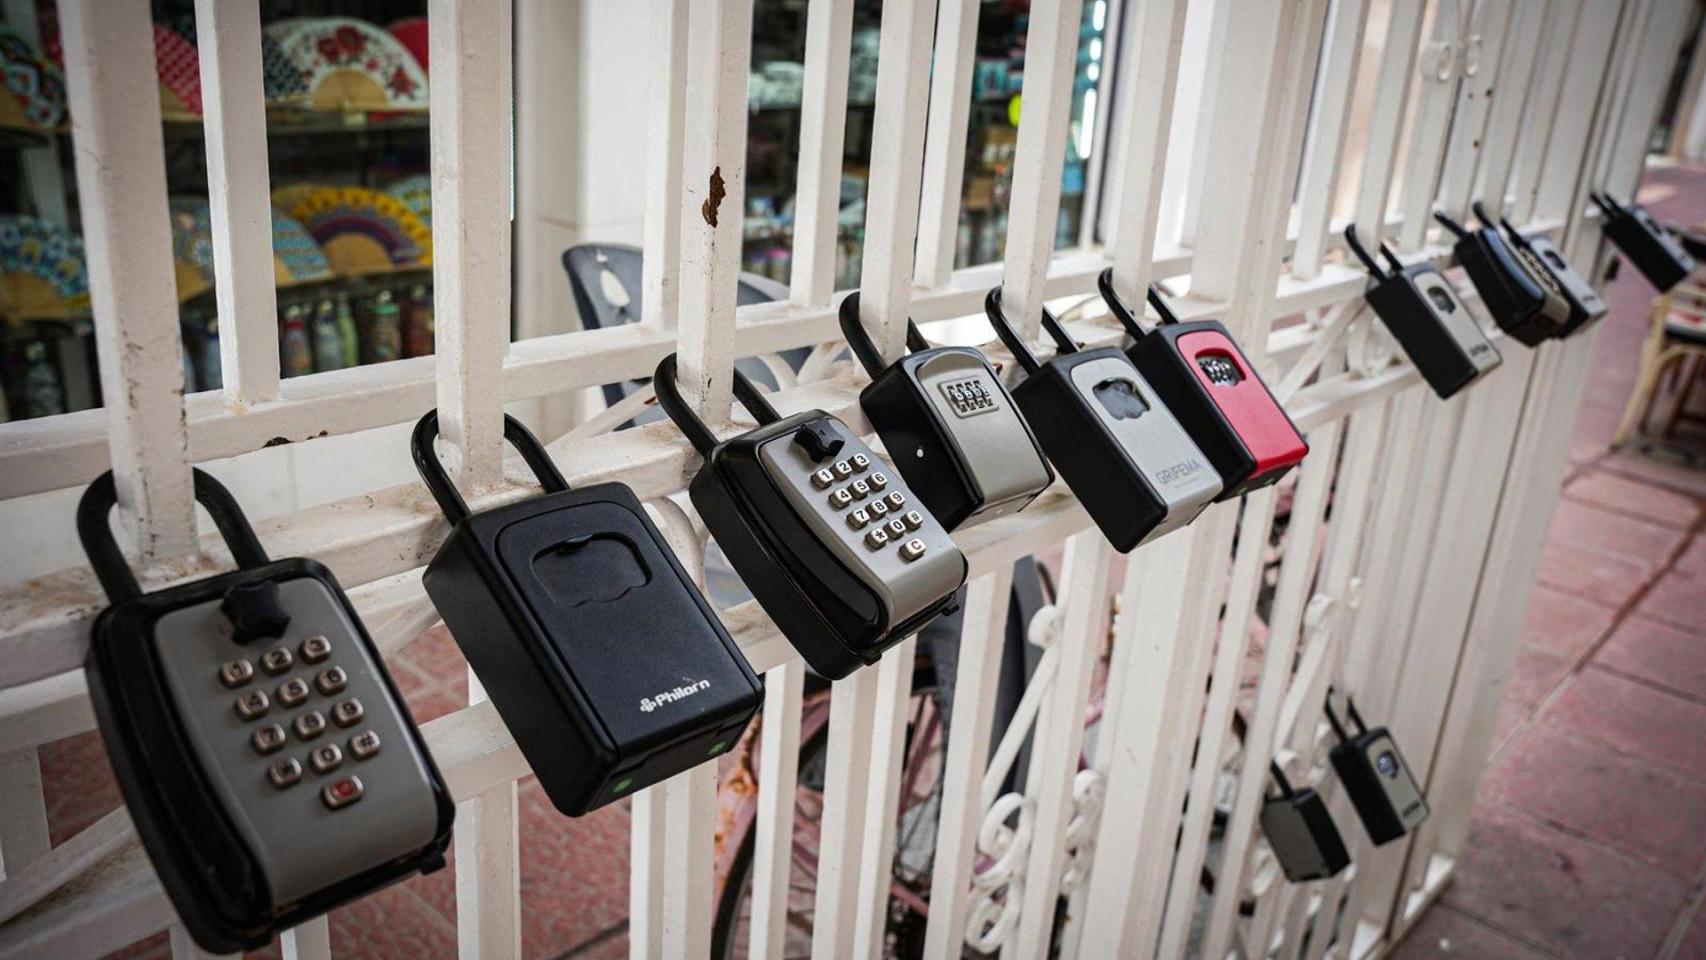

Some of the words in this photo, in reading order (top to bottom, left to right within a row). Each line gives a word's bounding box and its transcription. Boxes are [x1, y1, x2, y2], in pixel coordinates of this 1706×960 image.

[839, 462, 849, 472] 2
[856, 454, 867, 464] 3
[857, 481, 867, 491] 5
[875, 473, 885, 482] 6
[856, 510, 865, 520] 7
[875, 501, 885, 511] 8
[893, 492, 903, 502] 9
[893, 520, 903, 530] 0
[910, 540, 922, 550] C
[654, 679, 711, 706] Philorn
